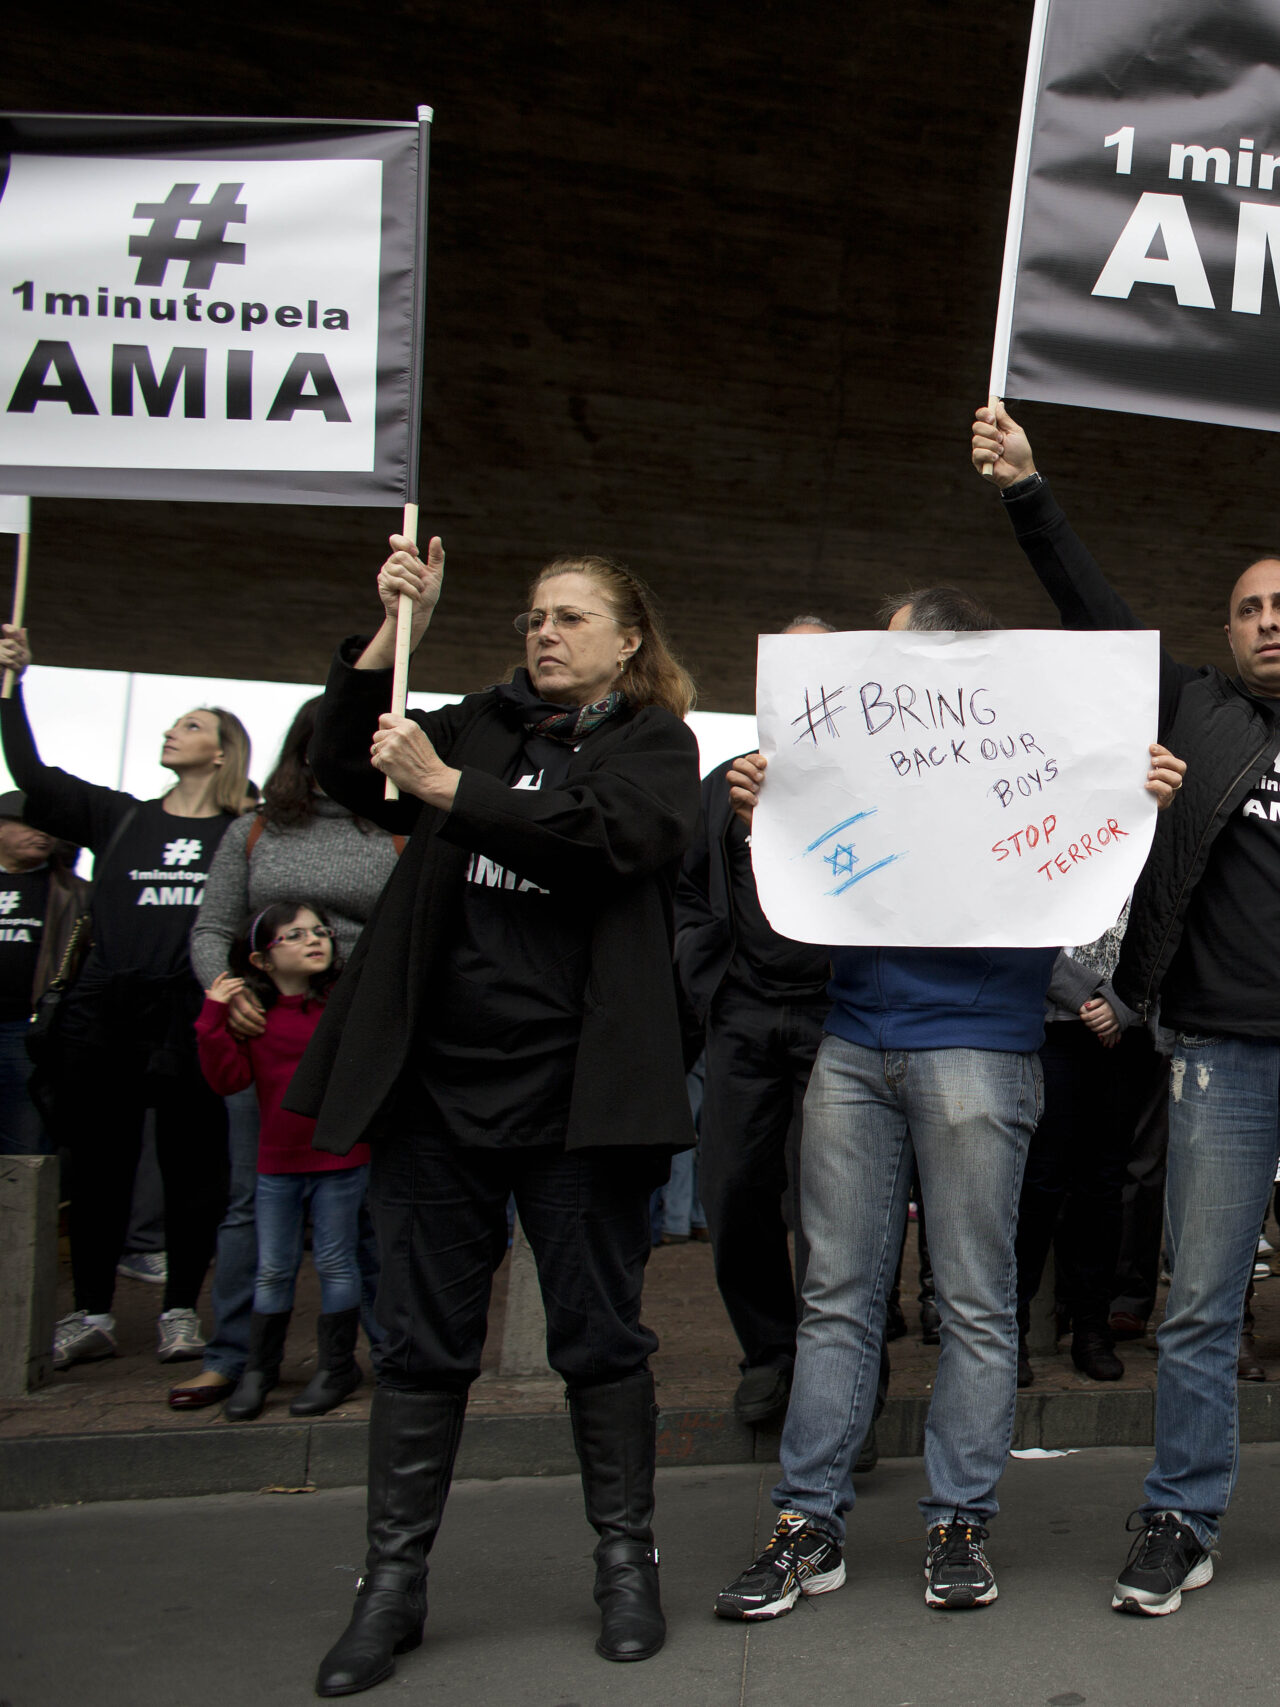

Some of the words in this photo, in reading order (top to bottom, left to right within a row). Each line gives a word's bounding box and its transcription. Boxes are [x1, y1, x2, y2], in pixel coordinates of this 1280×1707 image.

[1104, 126, 1135, 174] 1
[128, 182, 247, 290] #
[6, 340, 352, 423] AMIA
[890, 739, 971, 777] BACK
[980, 732, 1044, 764] OUR
[988, 759, 1060, 808] BOYS
[163, 838, 203, 866] #
[991, 814, 1057, 862] STOP
[1037, 818, 1130, 881] TERROR
[128, 869, 209, 883] 1minutop
[0, 929, 32, 942] IA
